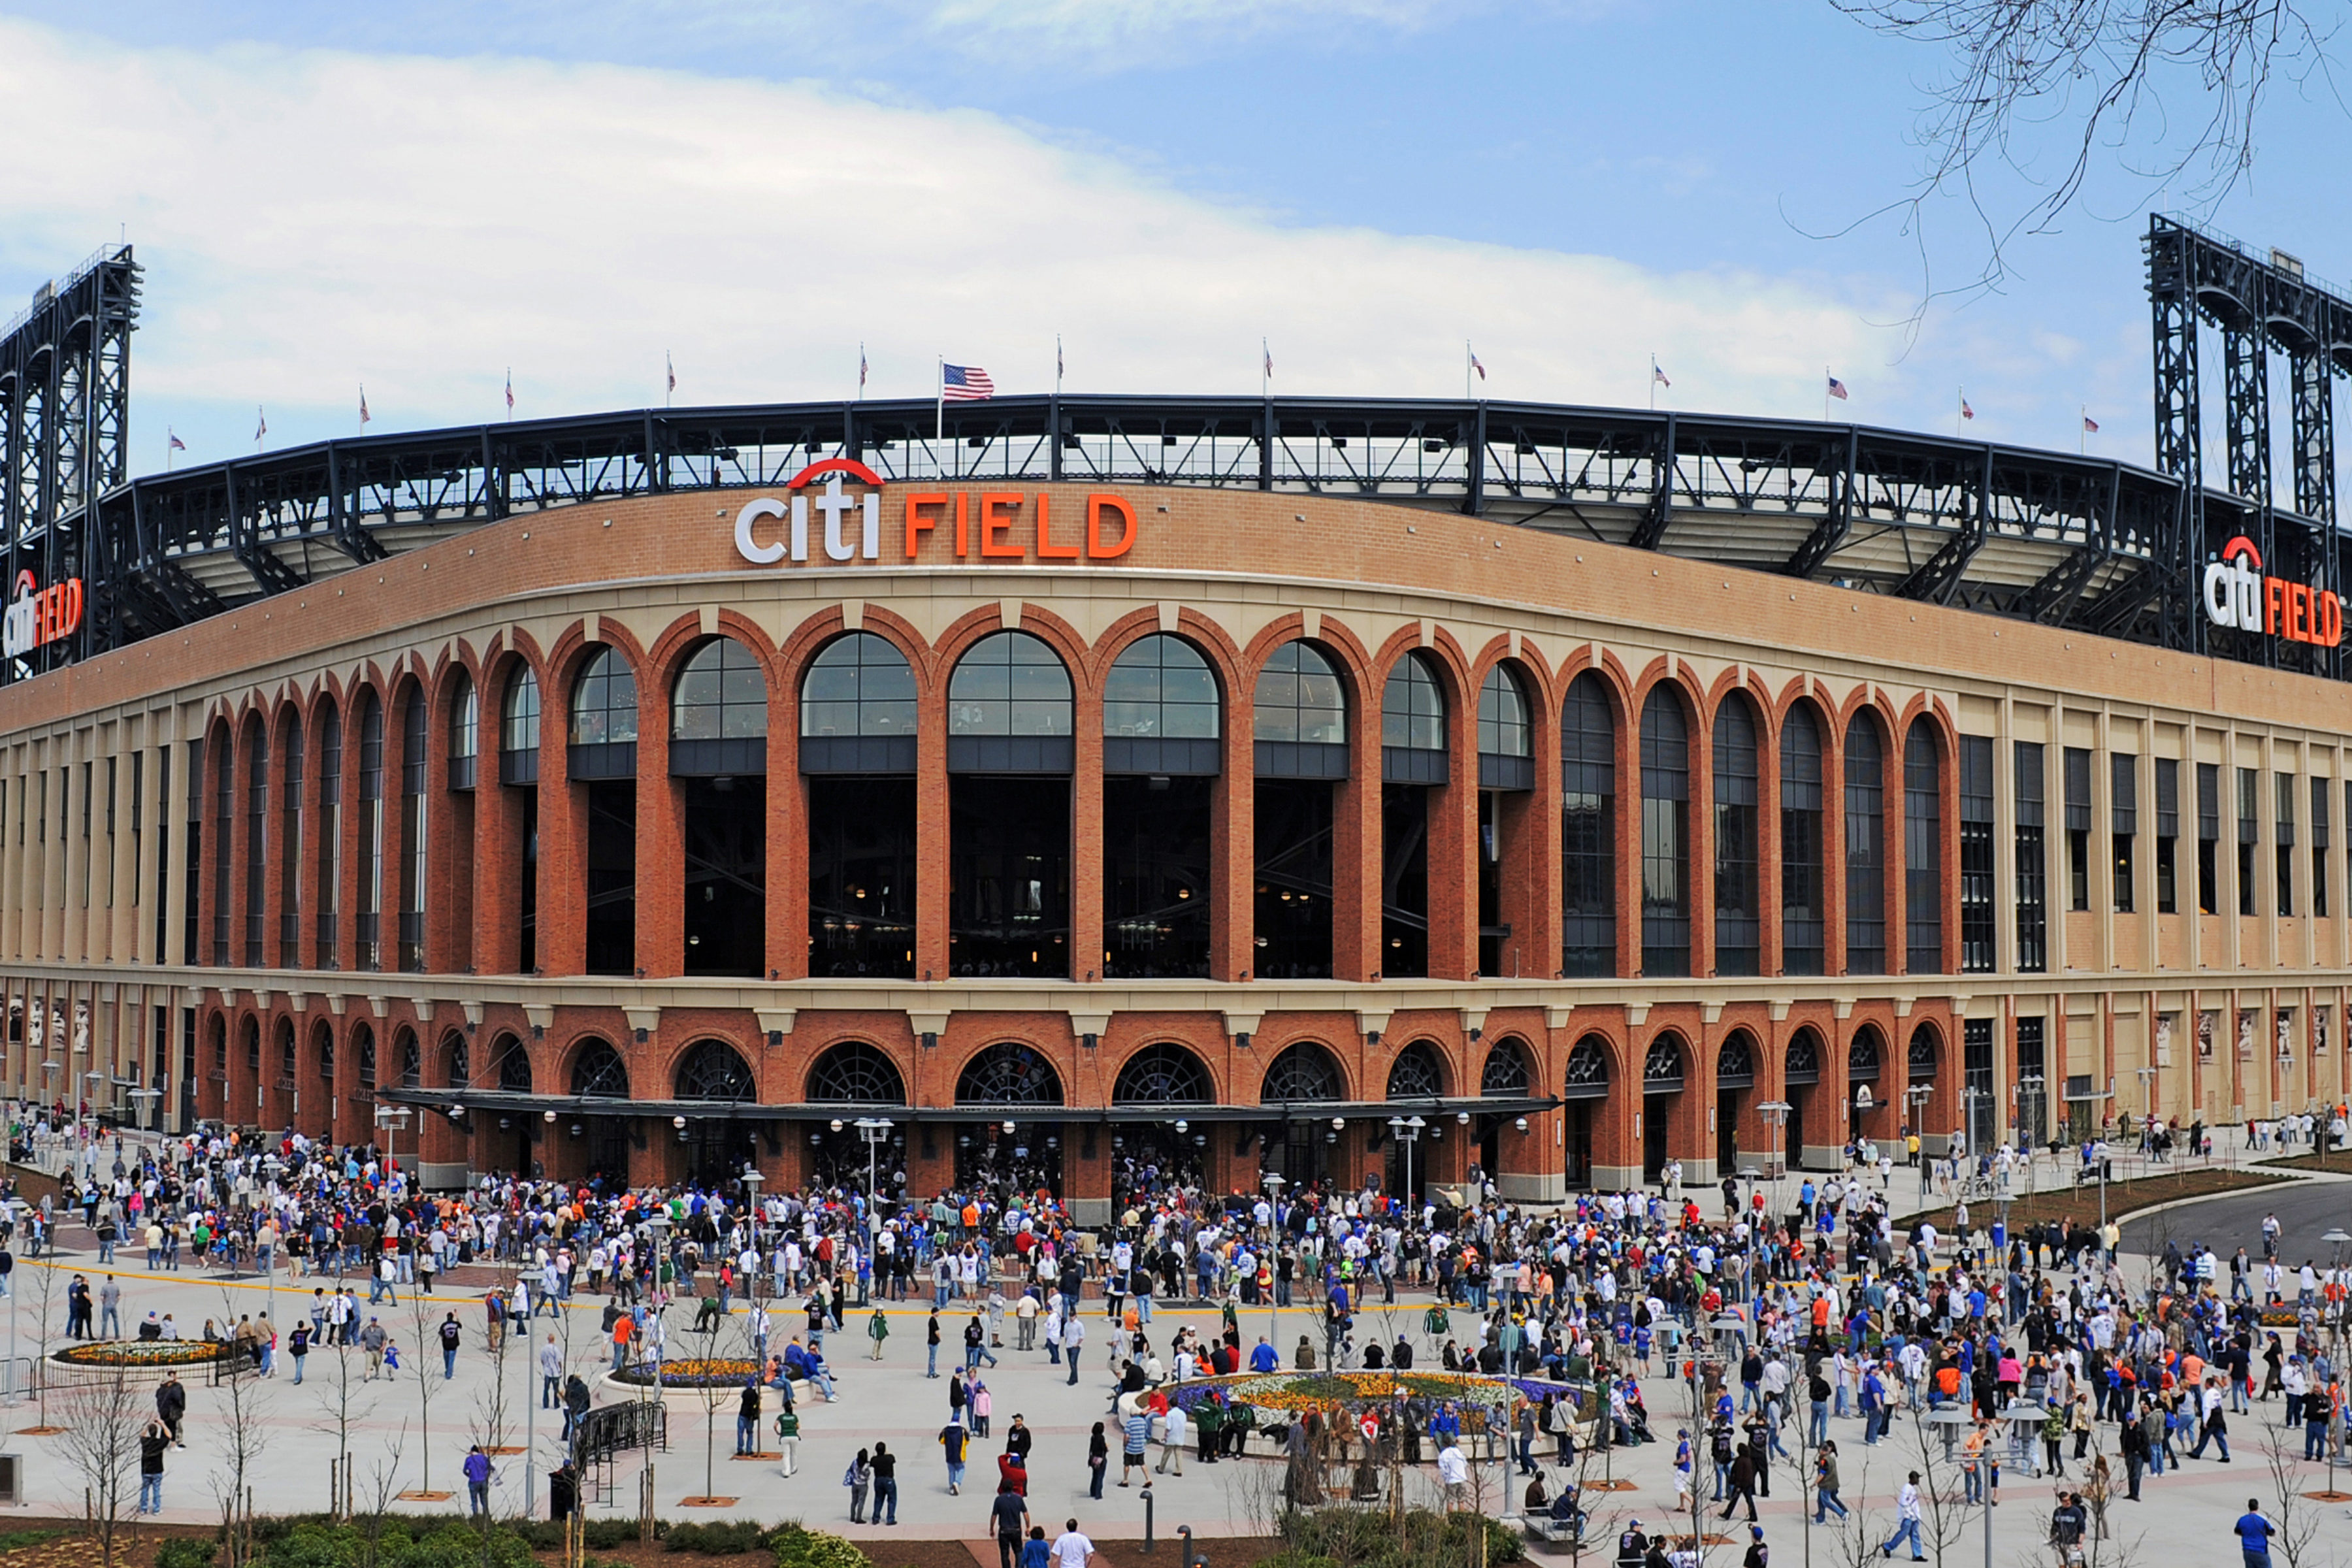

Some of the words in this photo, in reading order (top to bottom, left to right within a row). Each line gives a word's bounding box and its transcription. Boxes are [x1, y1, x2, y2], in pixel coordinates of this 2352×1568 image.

[734, 476, 879, 564] citi
[905, 492, 1137, 559] FIELD
[33, 577, 83, 647] FIELD
[2203, 552, 2262, 633] citi
[2264, 576, 2343, 647] FIELD
